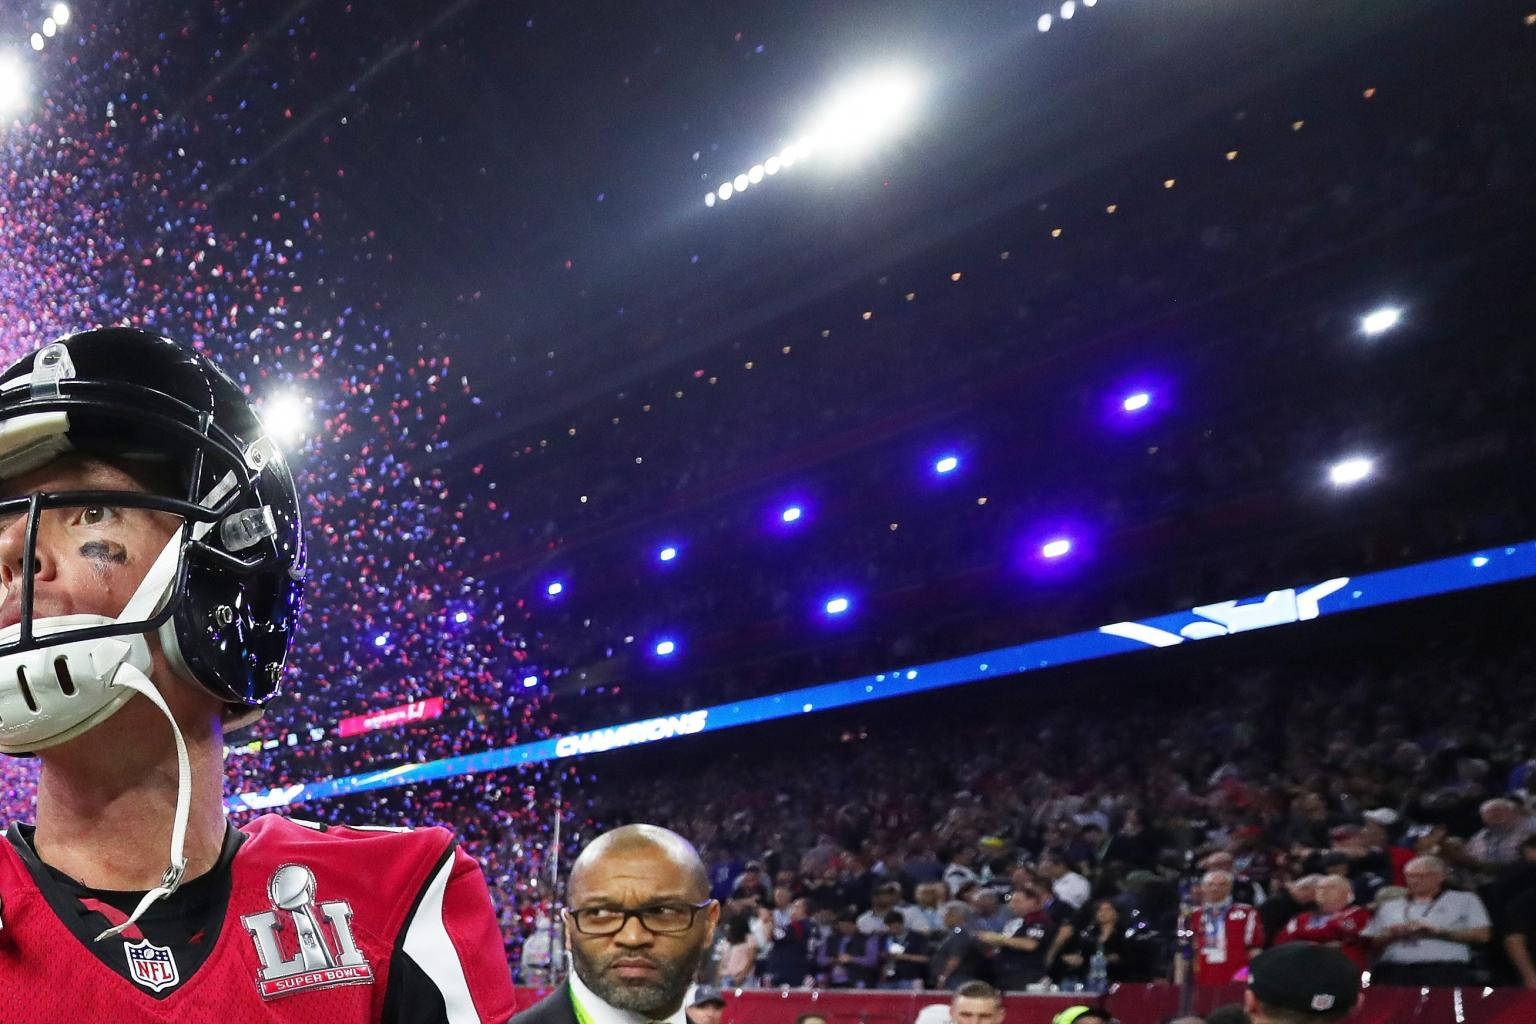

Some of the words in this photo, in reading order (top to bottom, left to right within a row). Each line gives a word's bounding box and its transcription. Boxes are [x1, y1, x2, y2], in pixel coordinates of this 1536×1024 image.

[136, 961, 172, 982] NFL
[276, 973, 323, 990] SUPER
[327, 967, 361, 980] BOWL
